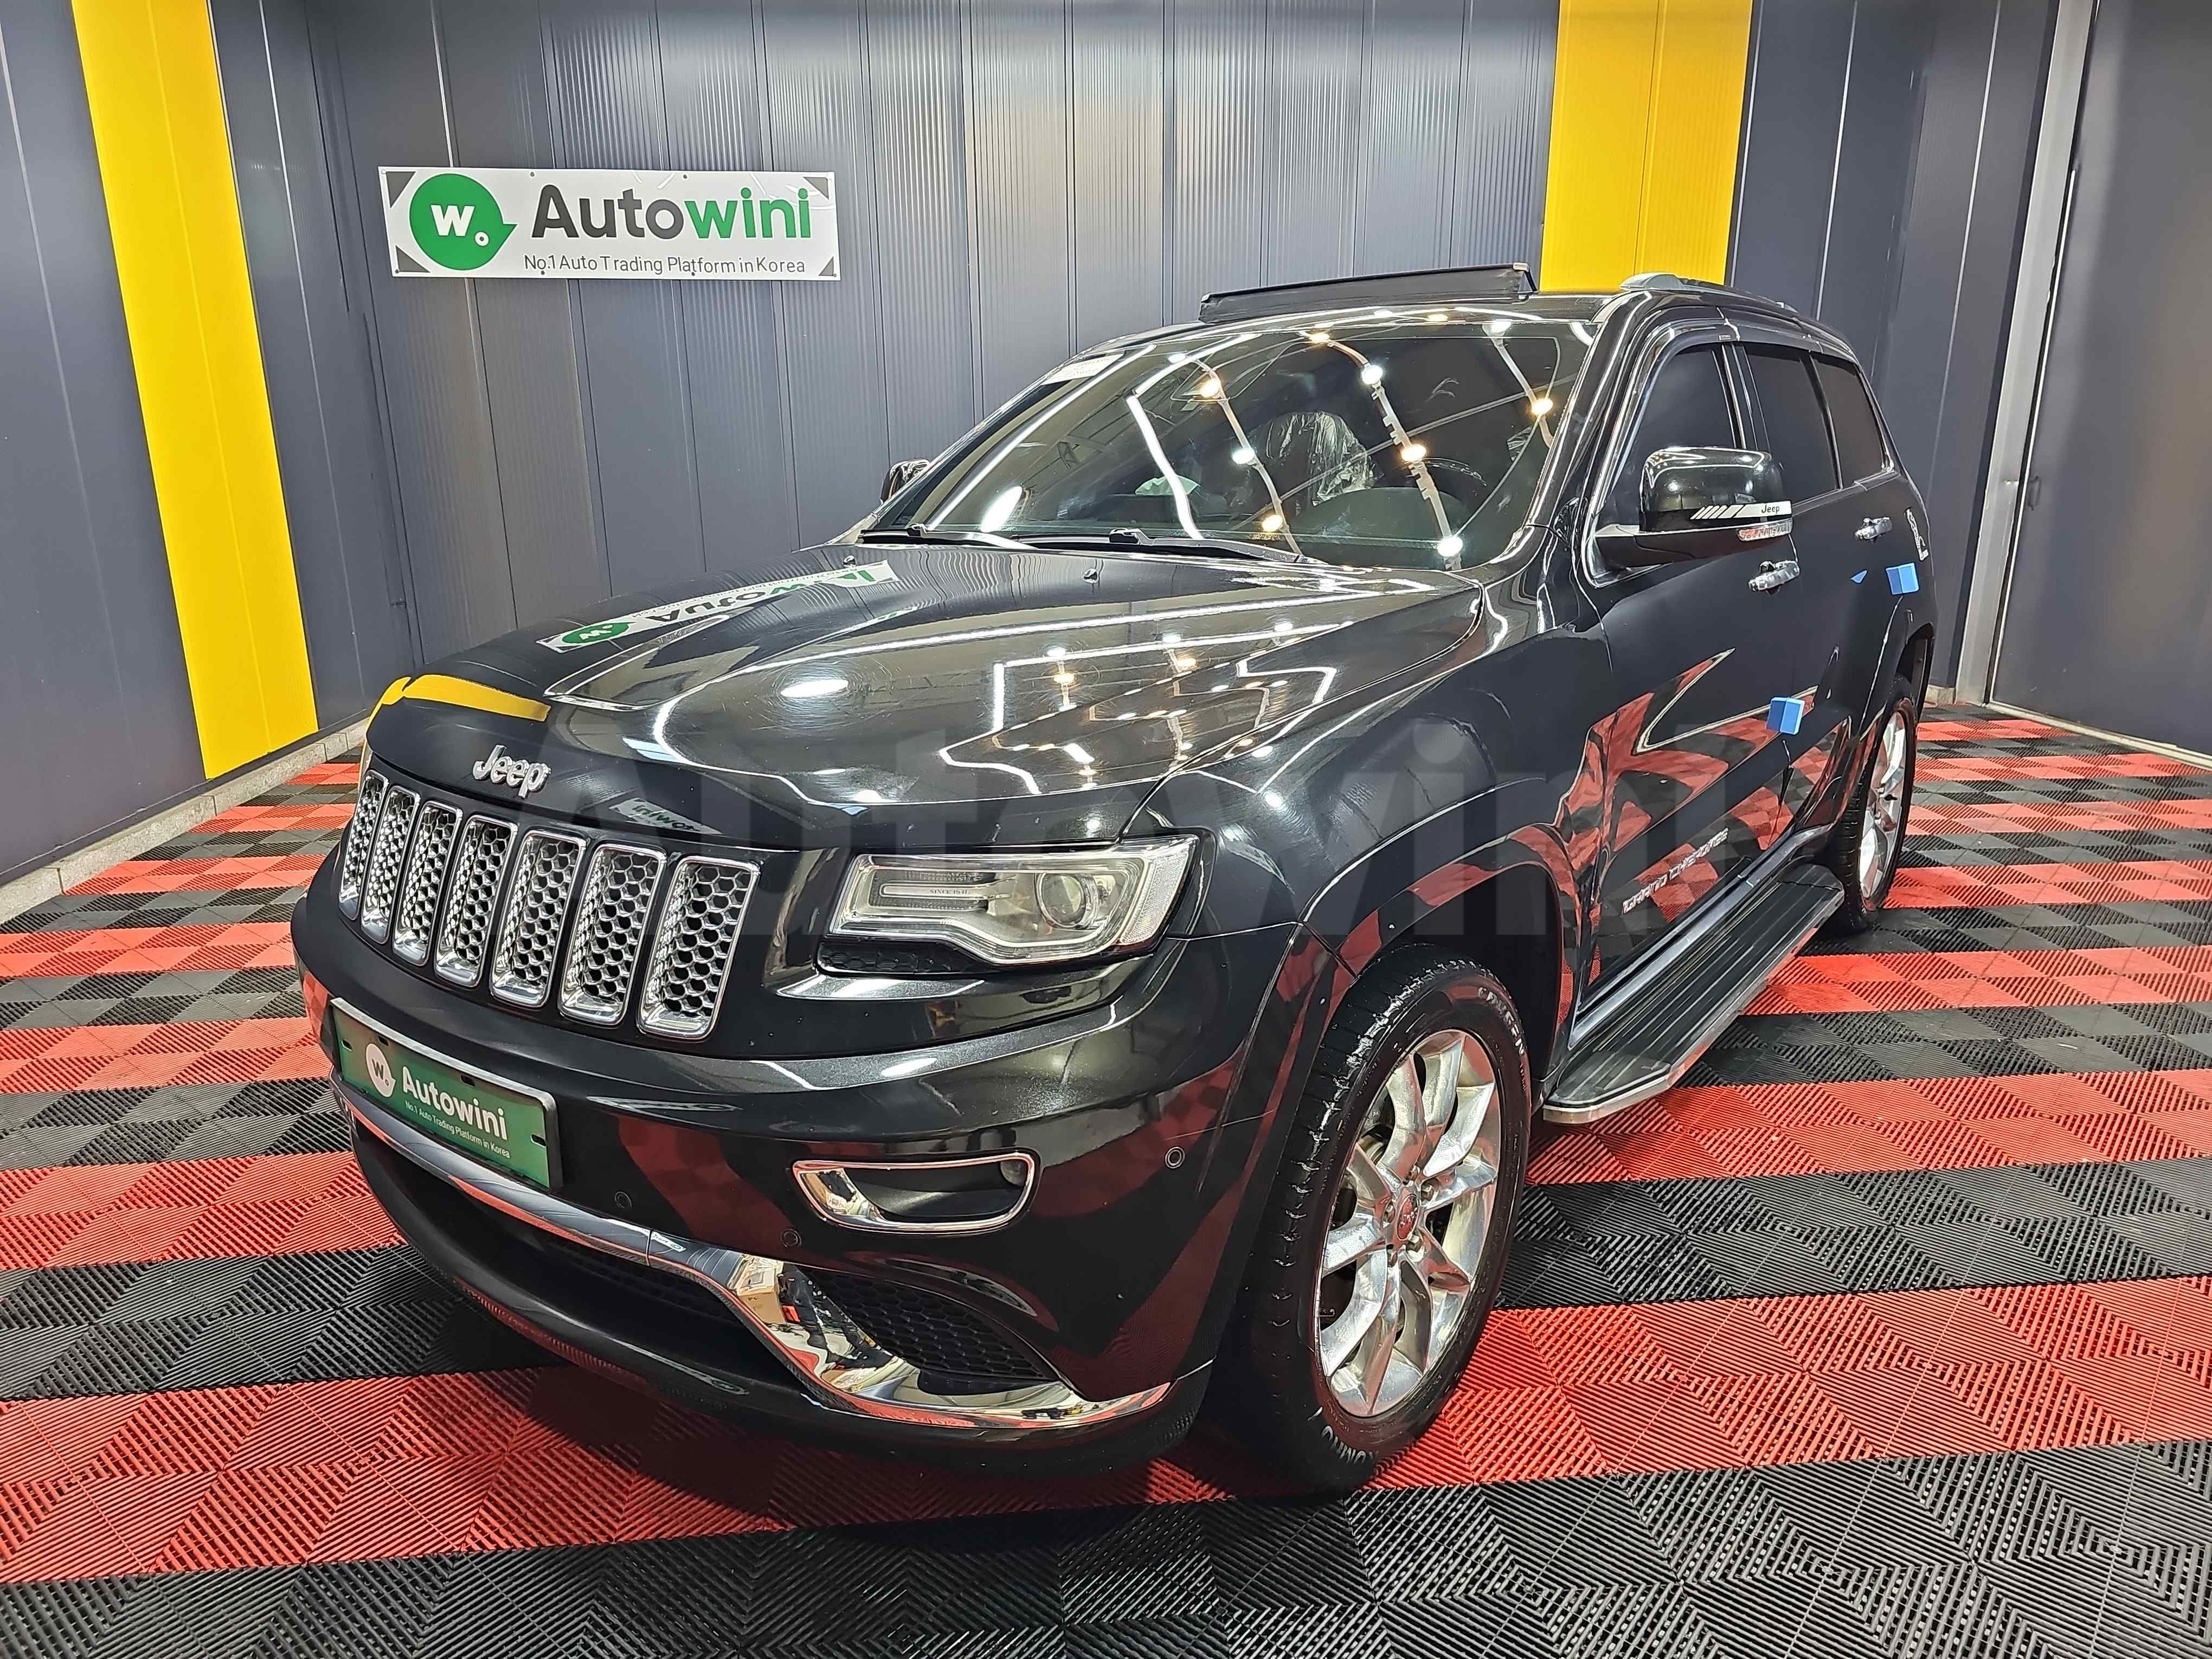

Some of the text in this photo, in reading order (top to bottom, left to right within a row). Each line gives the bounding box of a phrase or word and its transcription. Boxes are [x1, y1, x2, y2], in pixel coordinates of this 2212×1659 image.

[531, 184, 812, 240] Autowini
[524, 255, 805, 275] No.1 Auto Trading Platform in Korea
[1761, 505, 1780, 513] Jeep
[473, 744, 552, 799] Jeep
[402, 1066, 508, 1141] Autowini
[405, 1101, 511, 1159] No.1 Auto Trading Platform in Korea
